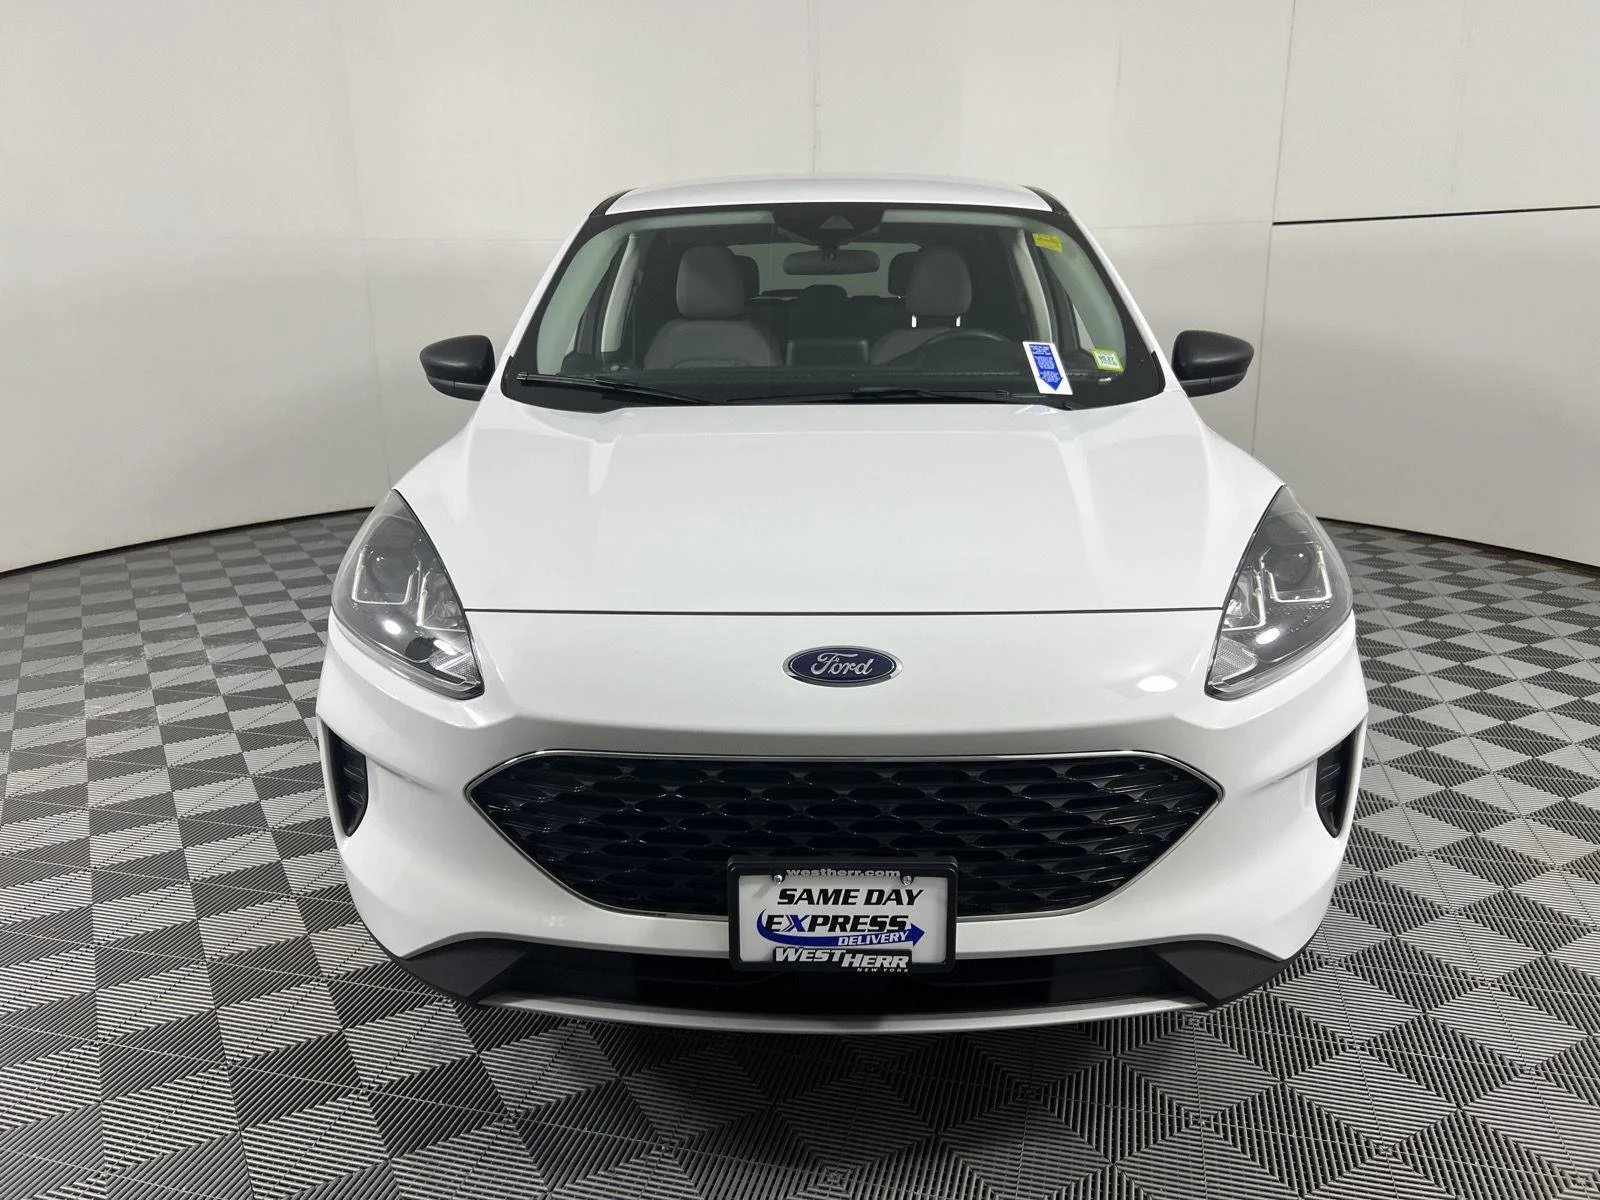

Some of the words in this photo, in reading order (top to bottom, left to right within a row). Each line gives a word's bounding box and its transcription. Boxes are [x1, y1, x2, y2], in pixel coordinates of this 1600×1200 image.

[810, 653, 874, 675] Ford
[786, 869, 900, 877] westherr.com
[777, 888, 861, 905] SAME
[864, 889, 924, 905] DAY
[765, 915, 909, 933] EXPRESS
[838, 932, 909, 946] DELIVERY
